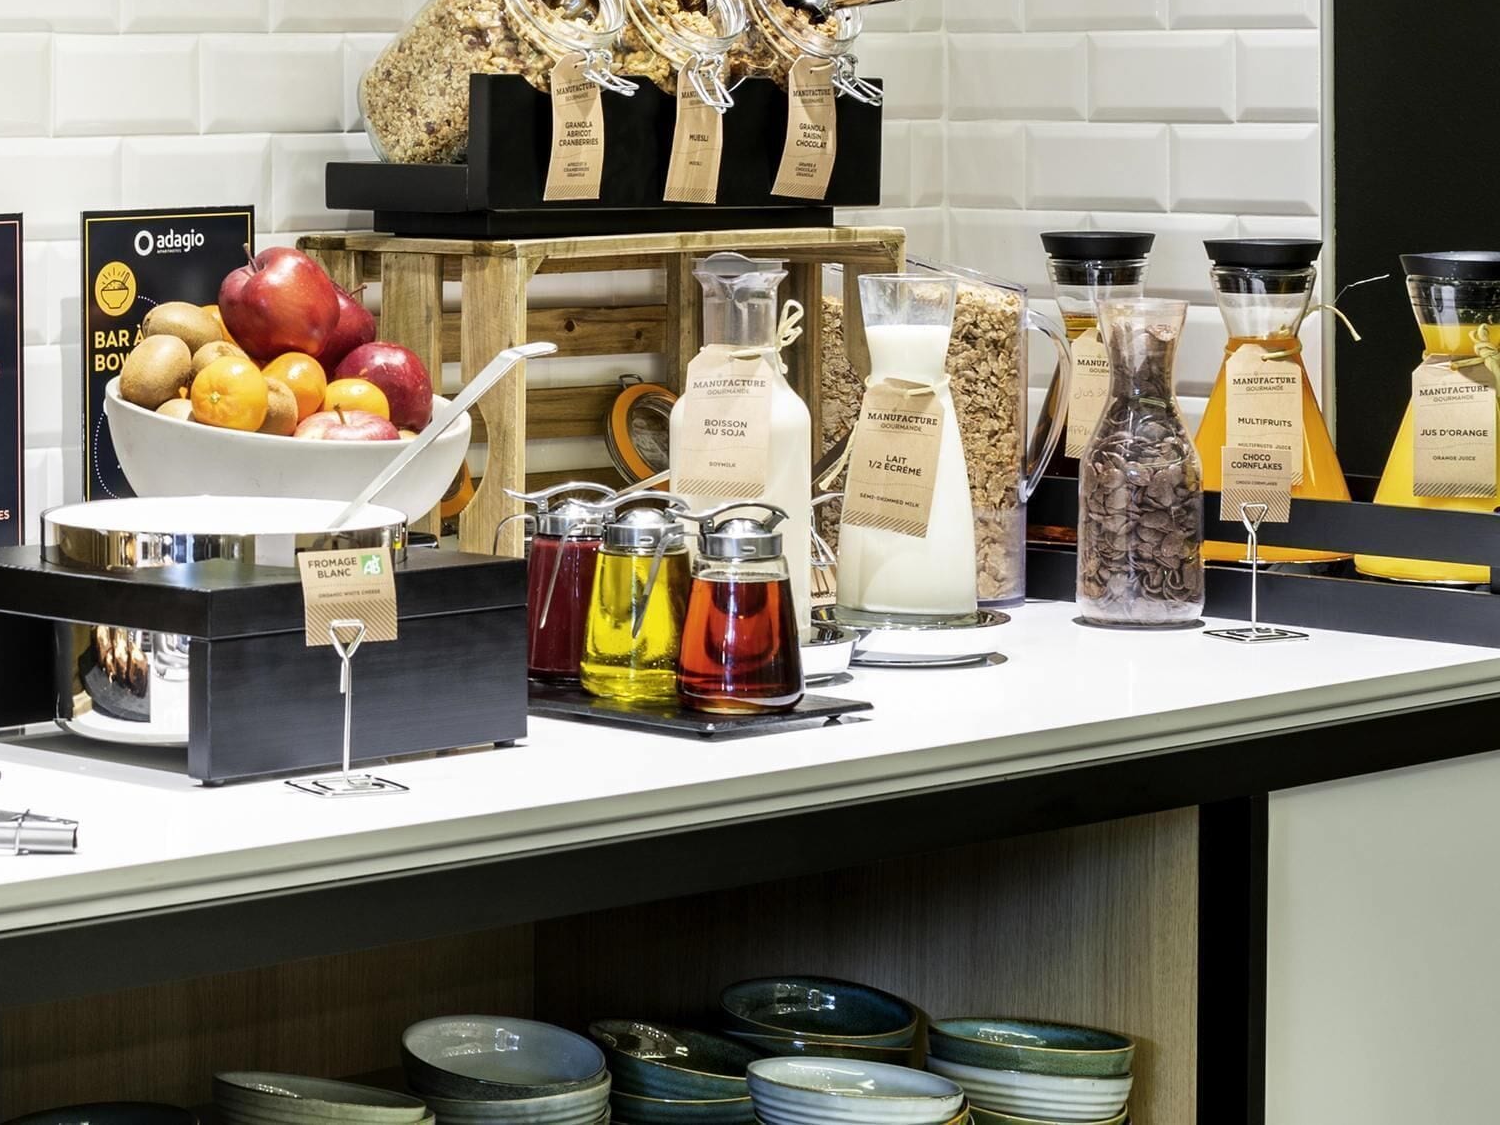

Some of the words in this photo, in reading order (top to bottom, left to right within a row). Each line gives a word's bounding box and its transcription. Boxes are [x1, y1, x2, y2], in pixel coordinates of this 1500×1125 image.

[565, 121, 593, 129] GRANOLA
[799, 123, 826, 132] GRANOLA
[559, 138, 599, 147] CRANBERRIES
[689, 134, 709, 142] MUESLI
[796, 139, 827, 148] CHOCOLAT
[156, 228, 205, 252] adagio
[94, 329, 130, 349] BAR
[133, 324, 146, 346] À
[692, 379, 766, 389] MANUFACTURE
[1232, 377, 1296, 385] MANUFACTURE
[1419, 385, 1489, 396] MANUFACTURE
[704, 419, 747, 428] BOISSON
[867, 412, 938, 426] MANUFACTURE
[1237, 417, 1292, 428] MULTIFRUITS
[721, 428, 746, 437] SOJA
[1439, 429, 1489, 437] D'ORANGE
[886, 455, 907, 465] LAIT
[1242, 453, 1271, 462] CHOCO
[868, 460, 882, 469] 1/2
[1231, 461, 1283, 471] CORNFLAKES
[307, 557, 357, 569] FROMAGE
[317, 568, 352, 579] BLANC
